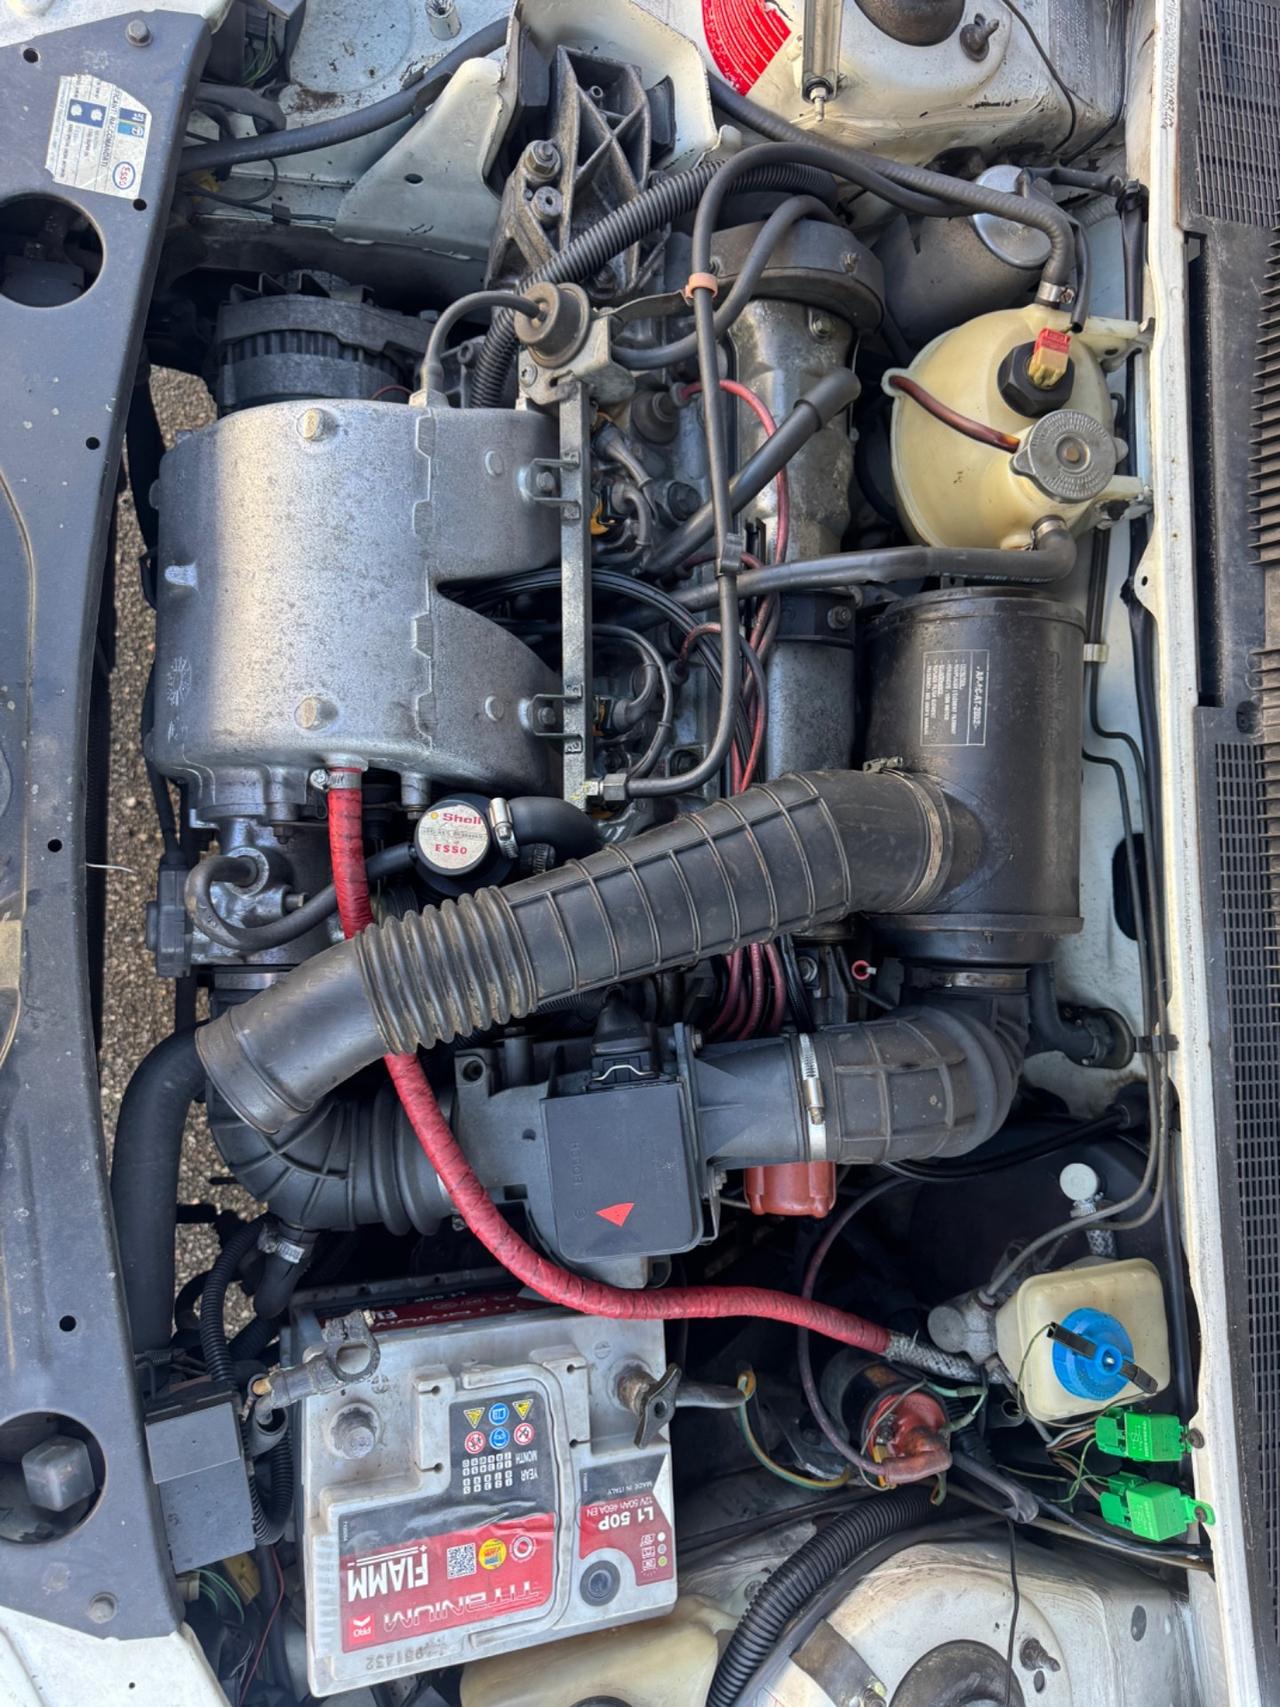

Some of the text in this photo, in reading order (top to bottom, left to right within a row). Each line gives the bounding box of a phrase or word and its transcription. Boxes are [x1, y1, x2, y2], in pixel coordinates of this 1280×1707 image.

[442, 813, 481, 825] Shell
[435, 843, 468, 855] ESSO
[515, 1450, 538, 1464] MONTH
[520, 1467, 539, 1482] YEAR
[607, 1486, 625, 1496] ITALY
[636, 1481, 653, 1490] MADE
[586, 1506, 599, 1518] EN
[597, 1506, 654, 1531] L1 50P
[348, 1552, 429, 1602] FIAMM
[383, 1580, 540, 1633] TITANIUM
[353, 1626, 372, 1637] PRO
